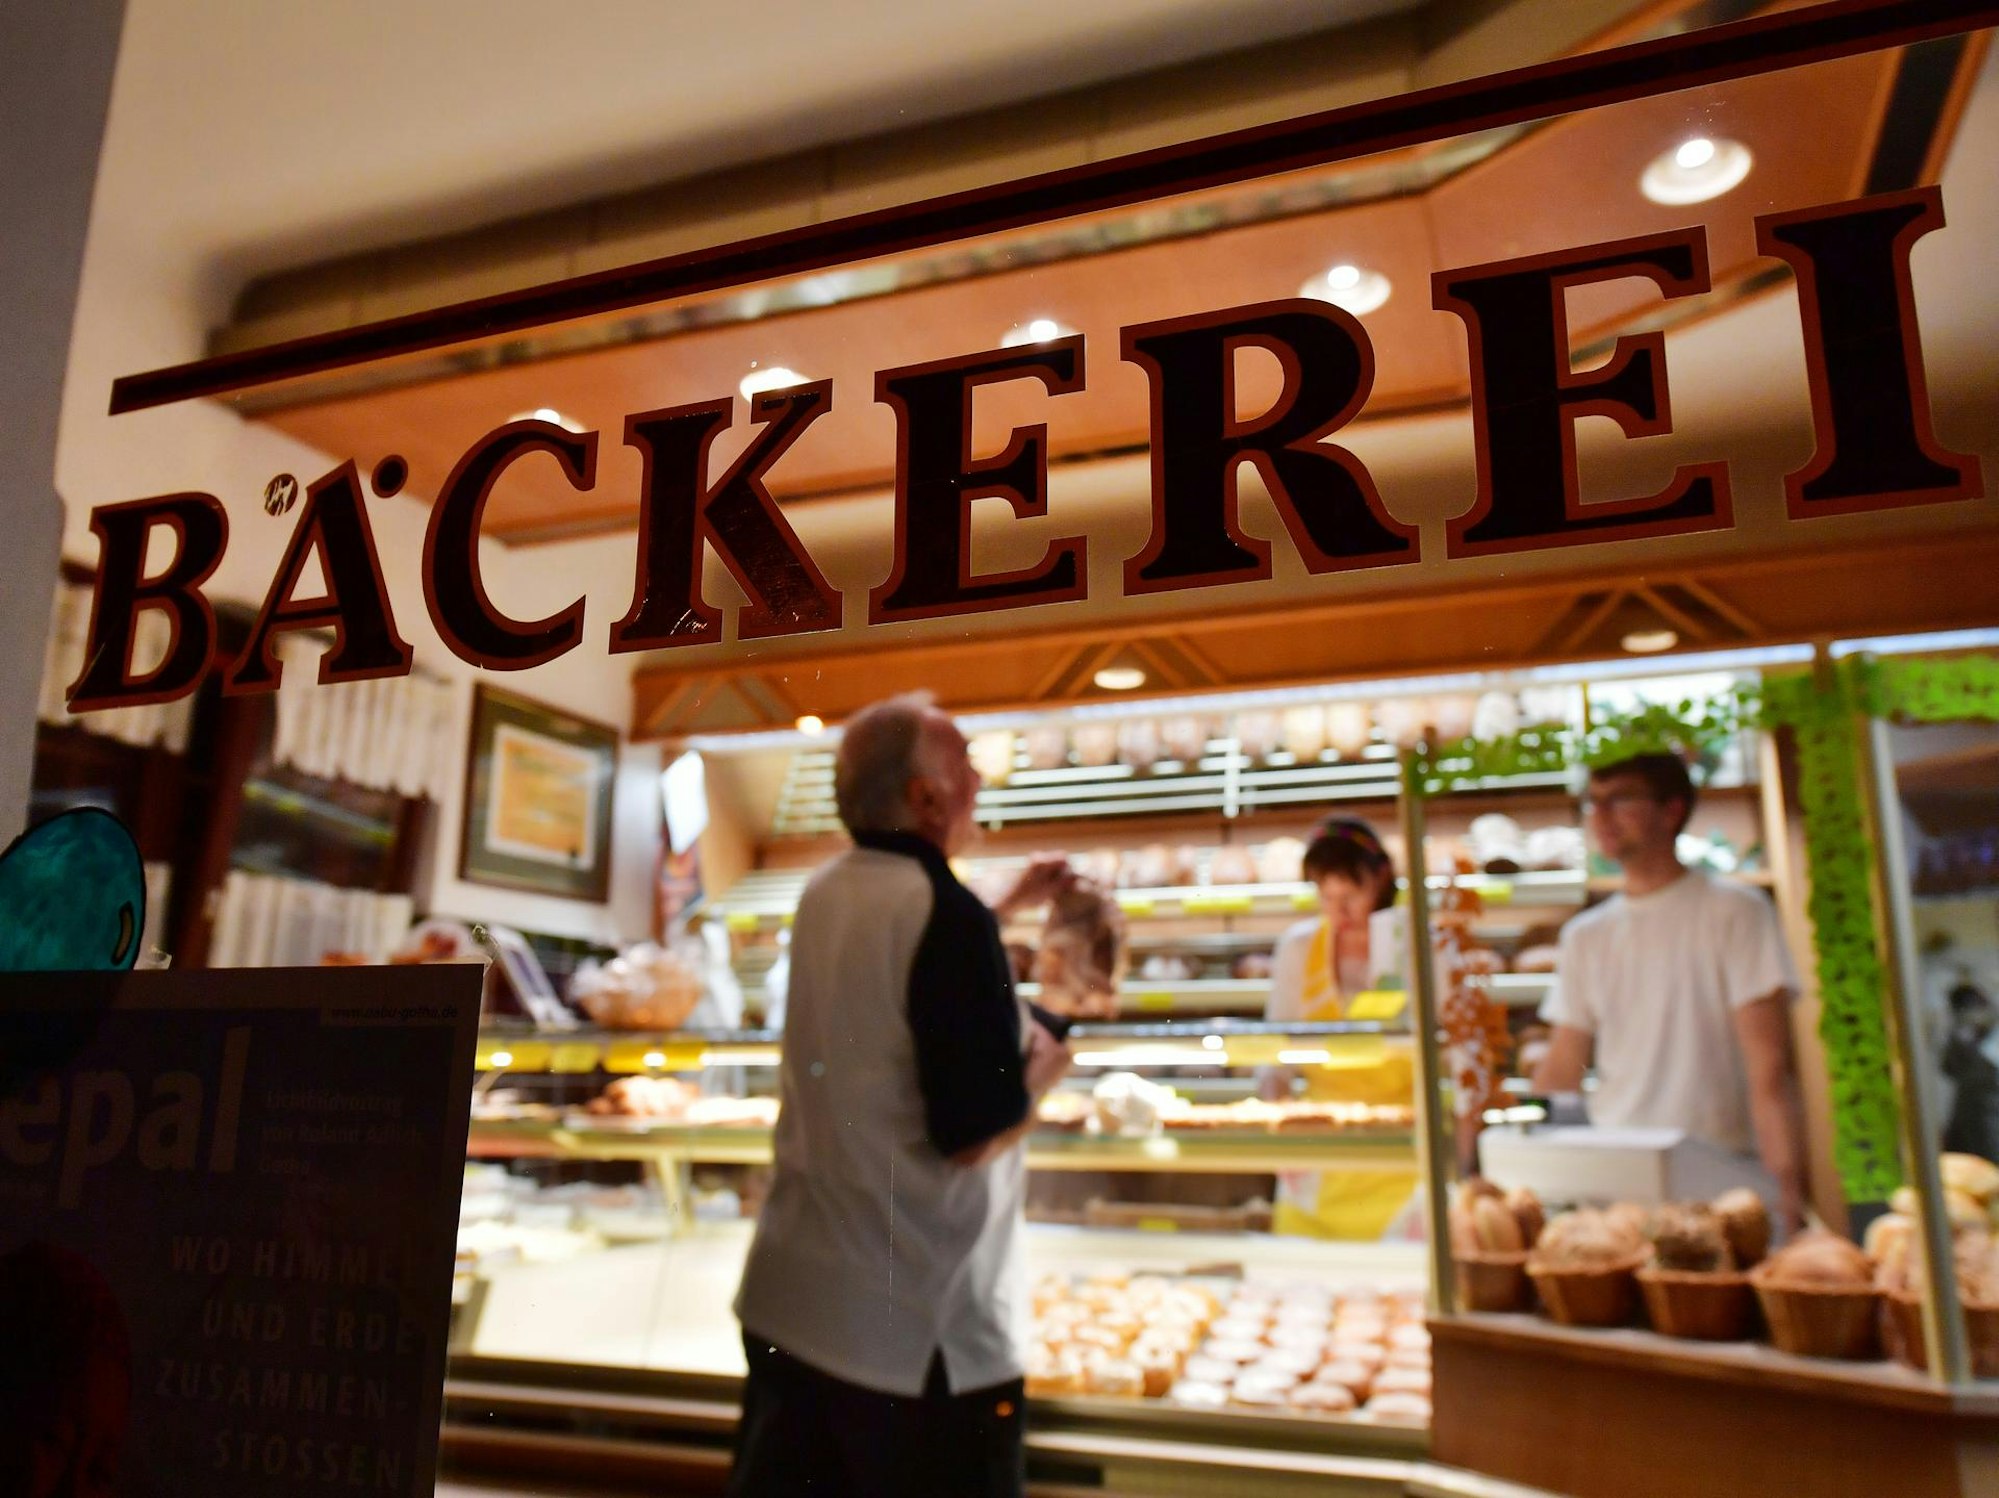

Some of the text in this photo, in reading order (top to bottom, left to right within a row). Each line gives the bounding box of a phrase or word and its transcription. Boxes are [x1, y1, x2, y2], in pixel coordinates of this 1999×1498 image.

[66, 184, 1984, 714] BÄCKEREI
[172, 1235, 231, 1275] WO
[202, 1299, 417, 1355] UND ERDE
[154, 1358, 409, 1419] ZUSAMMEN-
[212, 1428, 402, 1490] STOSSEN
